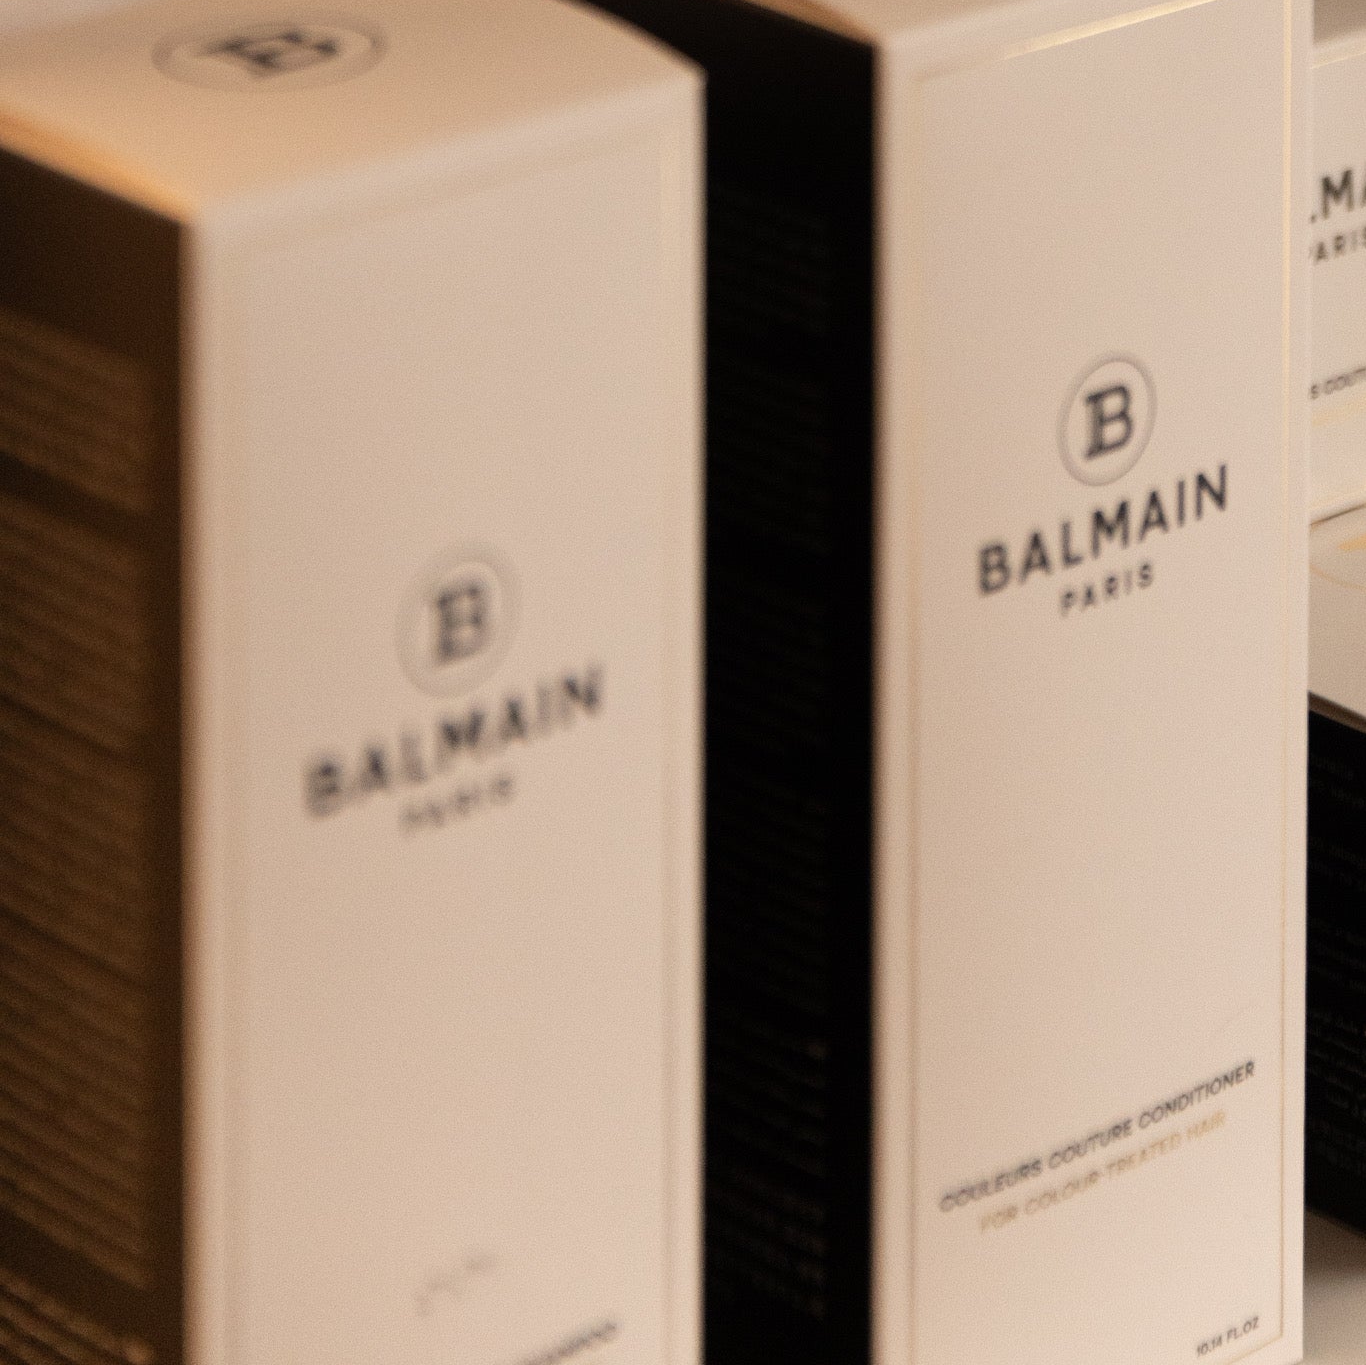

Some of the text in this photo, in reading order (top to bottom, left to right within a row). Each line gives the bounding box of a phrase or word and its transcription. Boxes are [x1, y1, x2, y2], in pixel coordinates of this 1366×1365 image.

[977, 463, 1228, 599] BALMAIN
[1060, 561, 1155, 619] PARIS
[302, 662, 606, 819] BALMAIN
[938, 1059, 1256, 1213] COULEURS COUTURE CONDITIONER
